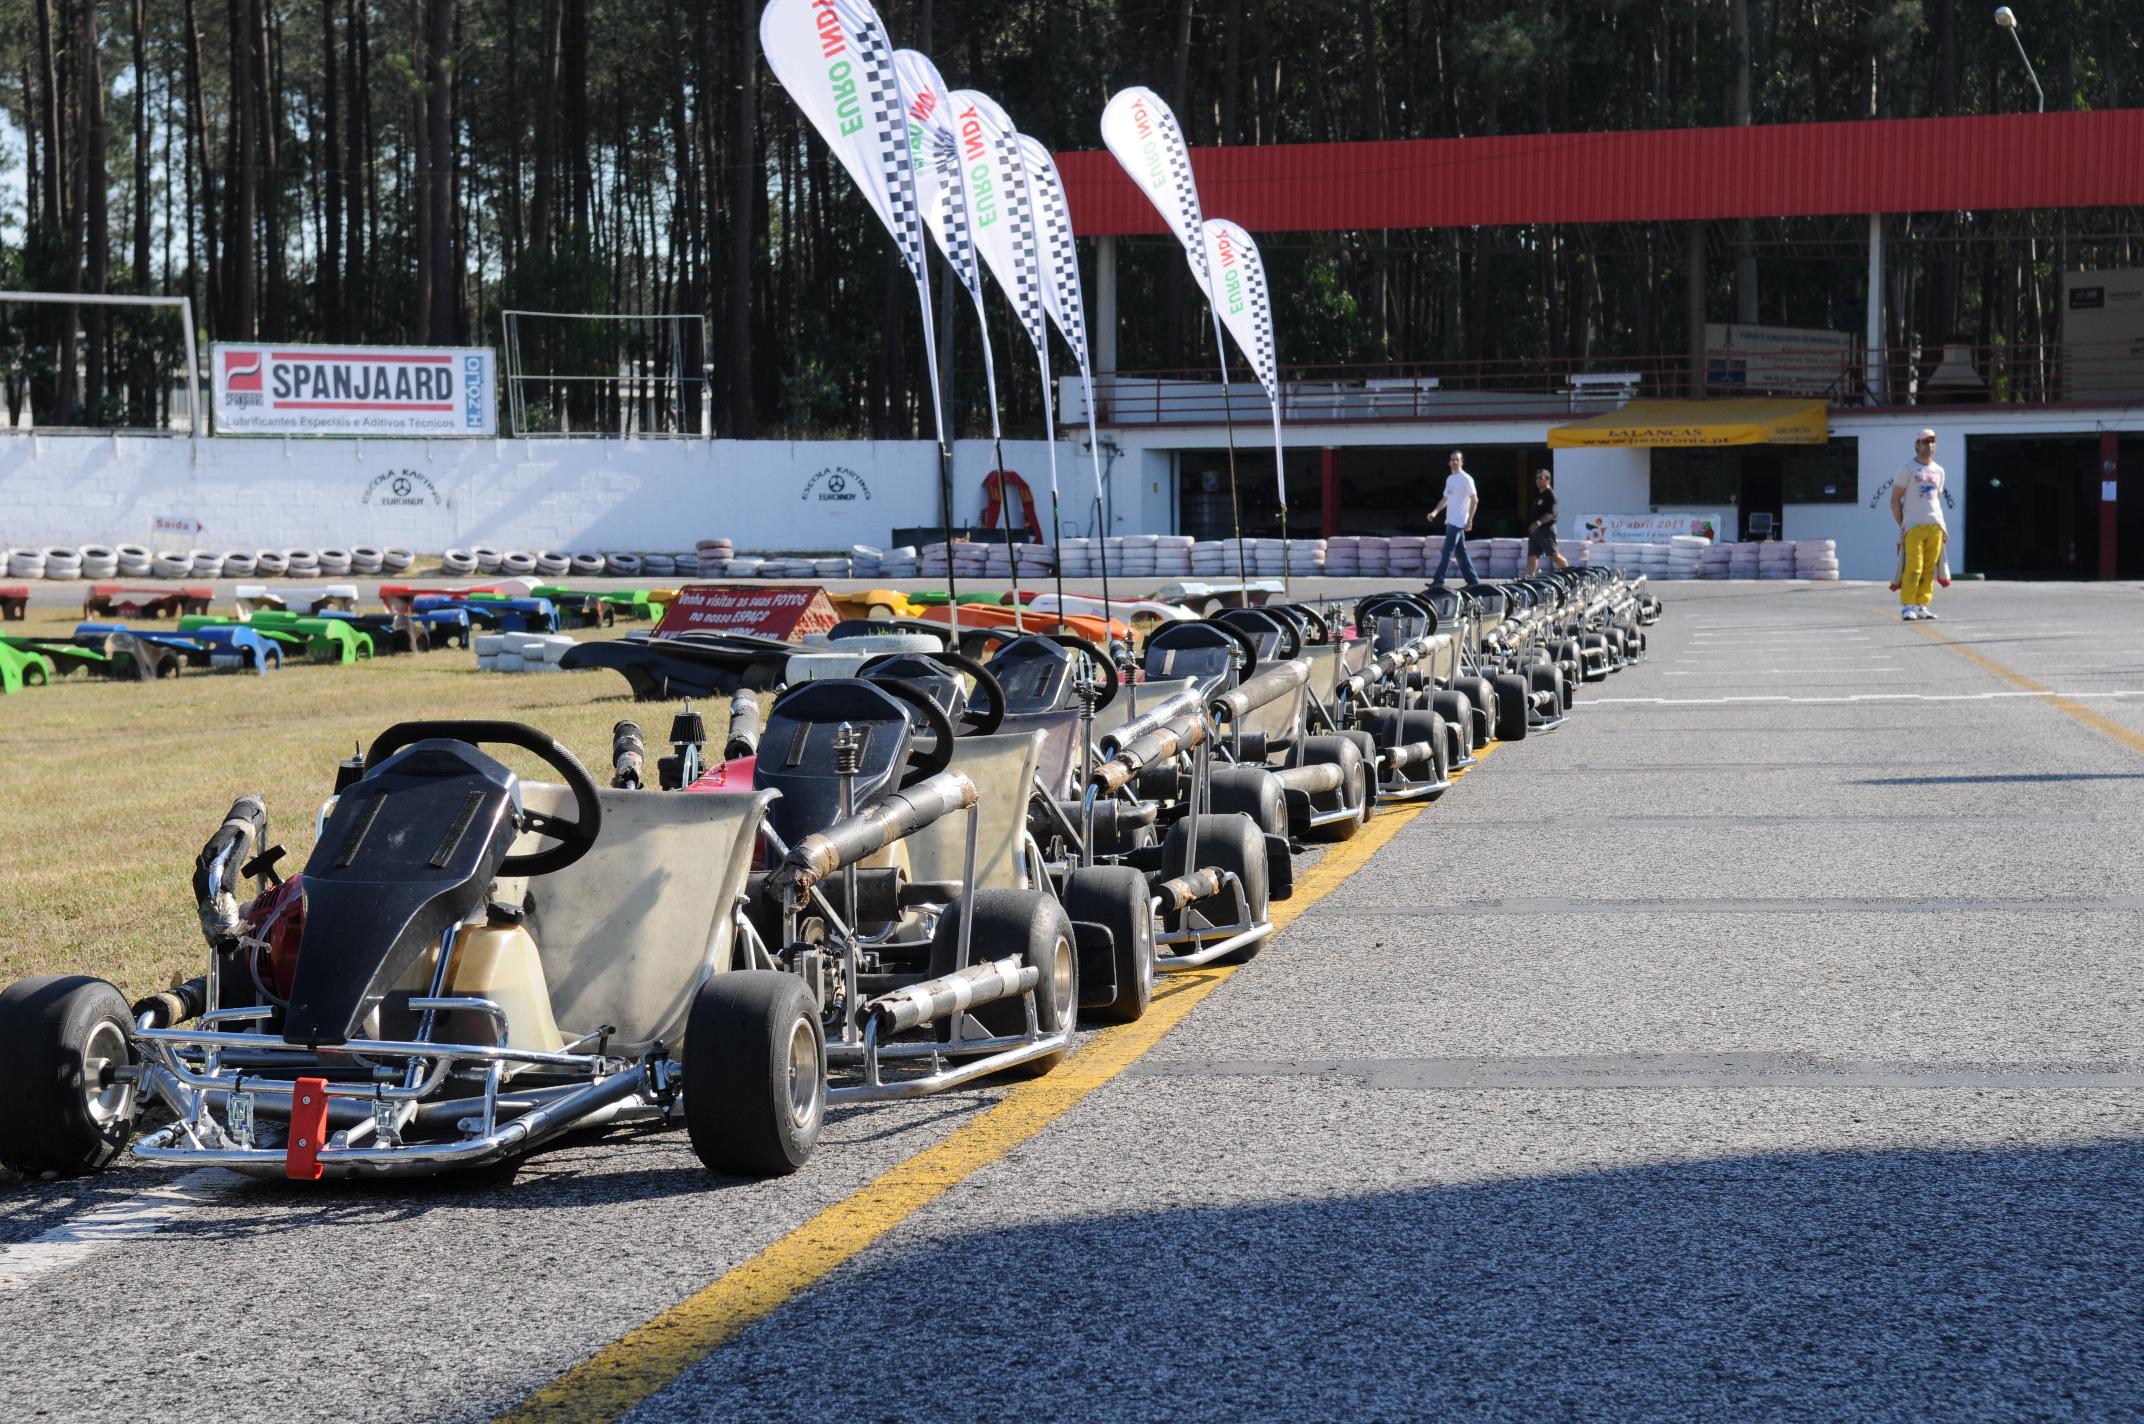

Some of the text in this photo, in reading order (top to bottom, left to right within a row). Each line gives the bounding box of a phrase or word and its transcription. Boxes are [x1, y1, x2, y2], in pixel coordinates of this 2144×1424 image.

[273, 363, 453, 400] SPANJAARD
[226, 416, 297, 427] Lubrificantes
[300, 416, 351, 428] Especiais
[362, 417, 406, 427] Aditivos
[362, 469, 442, 505] ESCOLA KARTING
[801, 466, 872, 501] ESCOLA KARTING
[818, 493, 857, 501] EUROINDY
[1626, 520, 1655, 529] abril
[677, 593, 808, 608] Venha visitar as suas FOTOS
[689, 611, 771, 624] no nosso ESPAÇO
